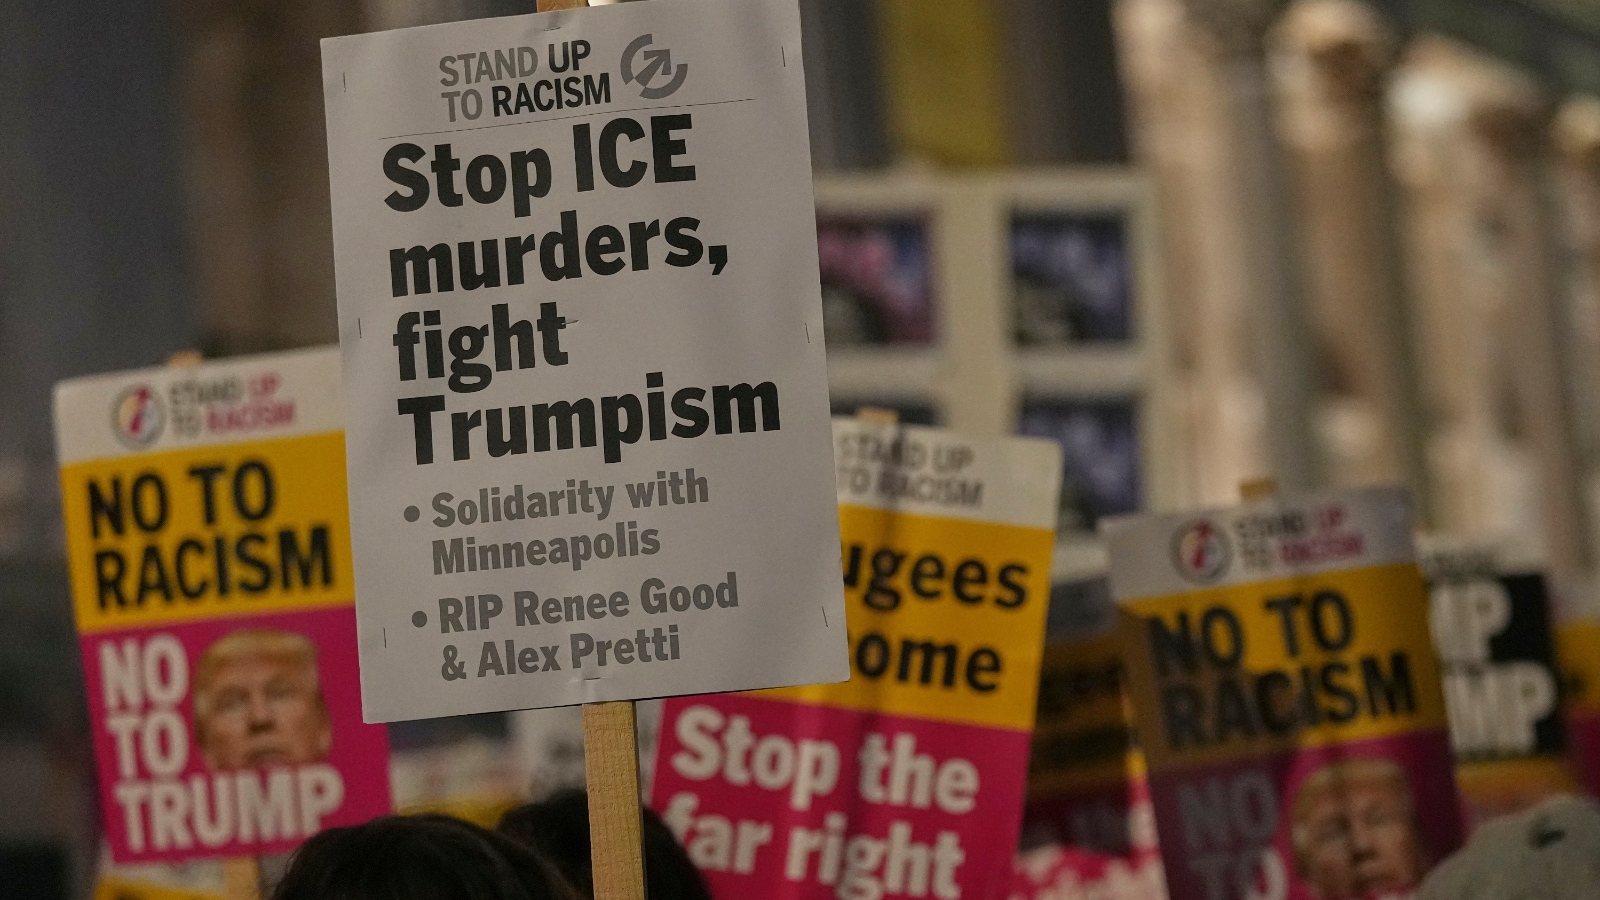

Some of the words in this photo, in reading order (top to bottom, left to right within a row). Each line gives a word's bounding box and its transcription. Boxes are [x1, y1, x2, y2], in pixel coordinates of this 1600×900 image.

[440, 46, 538, 87] STAND
[547, 39, 591, 73] UP
[441, 88, 483, 122] TO
[493, 72, 612, 117] RACISM
[382, 142, 552, 219] Stop
[572, 113, 697, 192] ICE
[389, 209, 728, 298] murders,
[392, 301, 569, 394] fight
[397, 371, 781, 466] Trumpism
[87, 471, 168, 539] NO
[188, 459, 276, 525] TO
[431, 479, 615, 528] Solidarity
[625, 468, 709, 508] with
[93, 525, 335, 610] RACISM
[431, 520, 661, 575] Minneapolis
[438, 593, 504, 634] RIP
[513, 590, 630, 627] Renee
[640, 571, 739, 615] Good
[1149, 604, 1246, 674] NO
[1263, 589, 1354, 657] TO
[99, 633, 189, 709] NO
[440, 644, 467, 682] &
[477, 639, 562, 678] Alex
[570, 624, 681, 669] Pretti
[848, 630, 1003, 694] ome
[1161, 652, 1417, 751] RACISM
[107, 713, 189, 777] TO
[670, 704, 841, 812] Stop
[858, 732, 980, 815] the
[115, 765, 345, 853] TRUMP
[663, 791, 773, 875] far
[784, 811, 967, 900] right
[1174, 769, 1279, 848] NO
